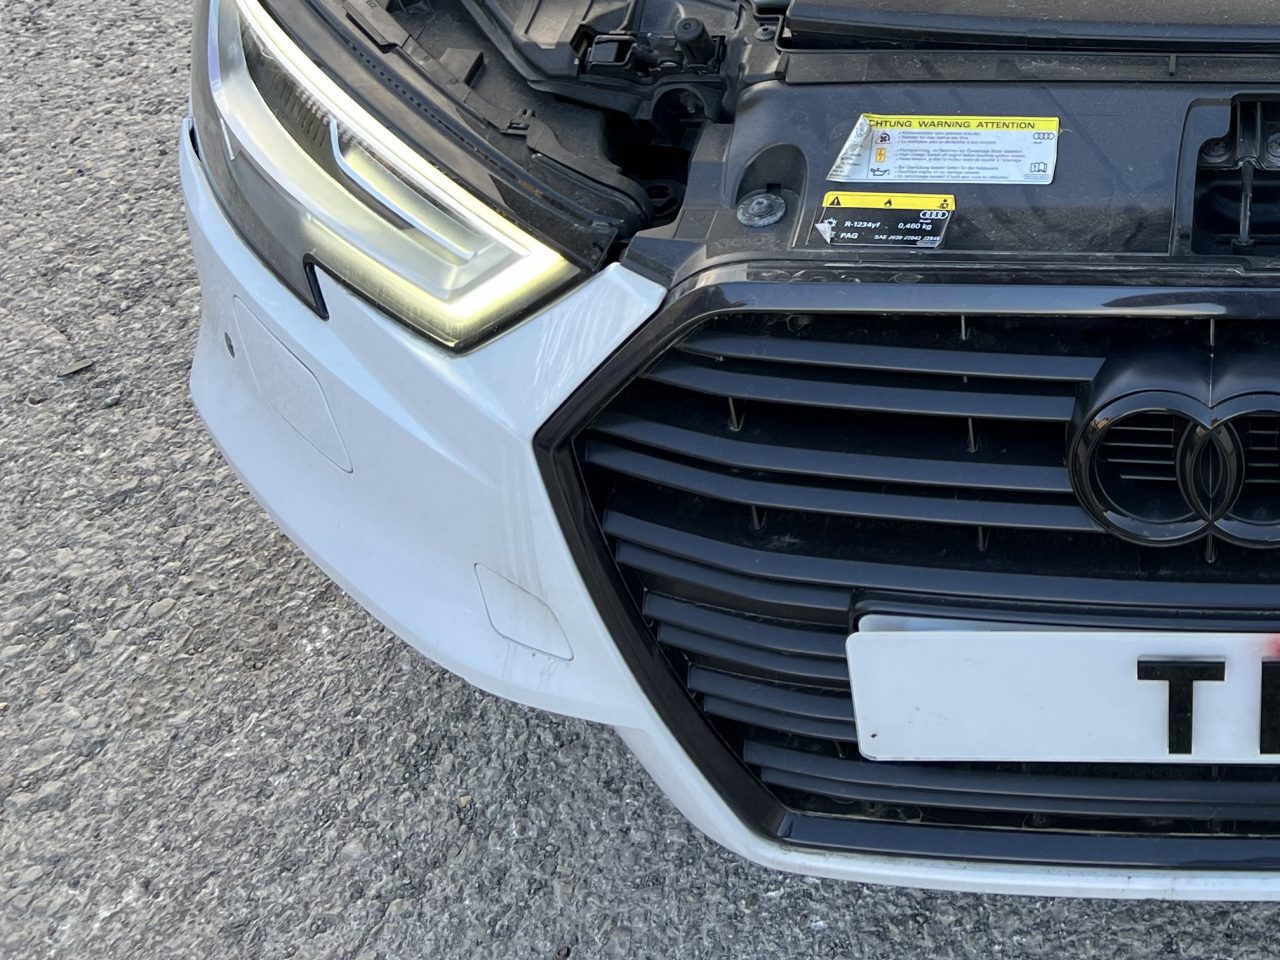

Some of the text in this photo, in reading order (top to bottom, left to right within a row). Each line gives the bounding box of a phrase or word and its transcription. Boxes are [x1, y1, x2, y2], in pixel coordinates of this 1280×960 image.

[869, 120, 1035, 129] CHTUNG WARNING ATTENTION
[844, 221, 881, 229] R-1234yf
[922, 223, 933, 231] kg
